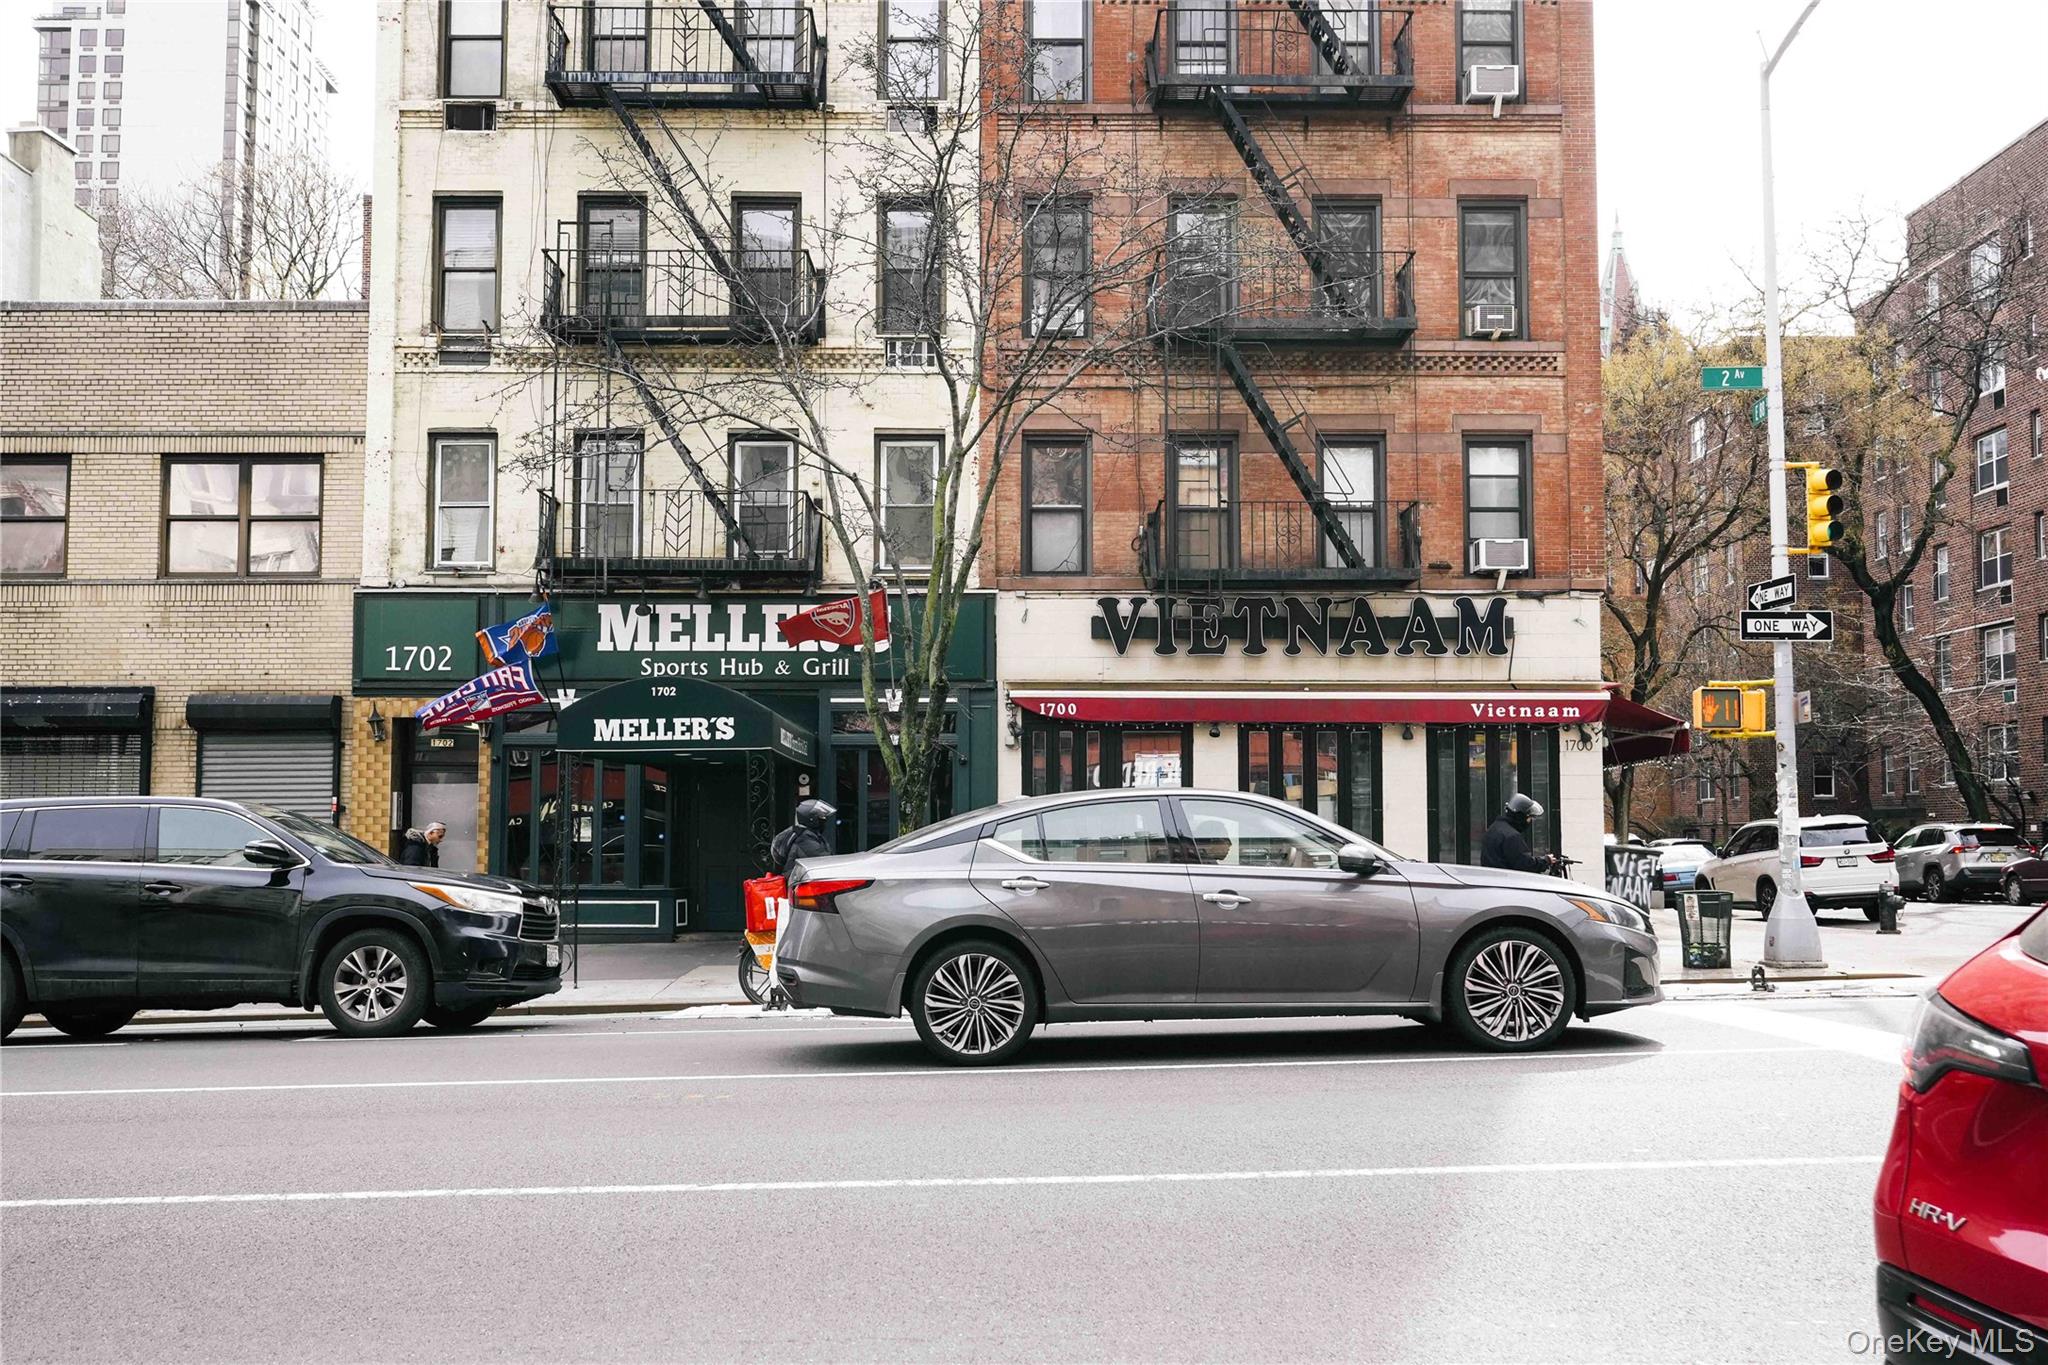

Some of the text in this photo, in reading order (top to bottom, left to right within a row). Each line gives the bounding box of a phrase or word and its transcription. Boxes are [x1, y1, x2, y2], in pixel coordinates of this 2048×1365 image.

[1721, 369, 1745, 386] 2 Av
[1755, 584, 1790, 604] ONE WAY
[1097, 597, 1508, 656] VIETNAAM
[1754, 620, 1818, 632] ONE WAY
[385, 646, 452, 671] 1702
[641, 657, 849, 677] Sports Hub & Grill
[651, 687, 676, 696] 1702
[1039, 703, 1077, 717] 1700
[1471, 703, 1580, 717] Vietnaam
[593, 717, 735, 742] MELLER'S
[431, 739, 453, 747] 1702
[1565, 739, 1593, 751] 1700
[1908, 1197, 1967, 1231] HR-V
